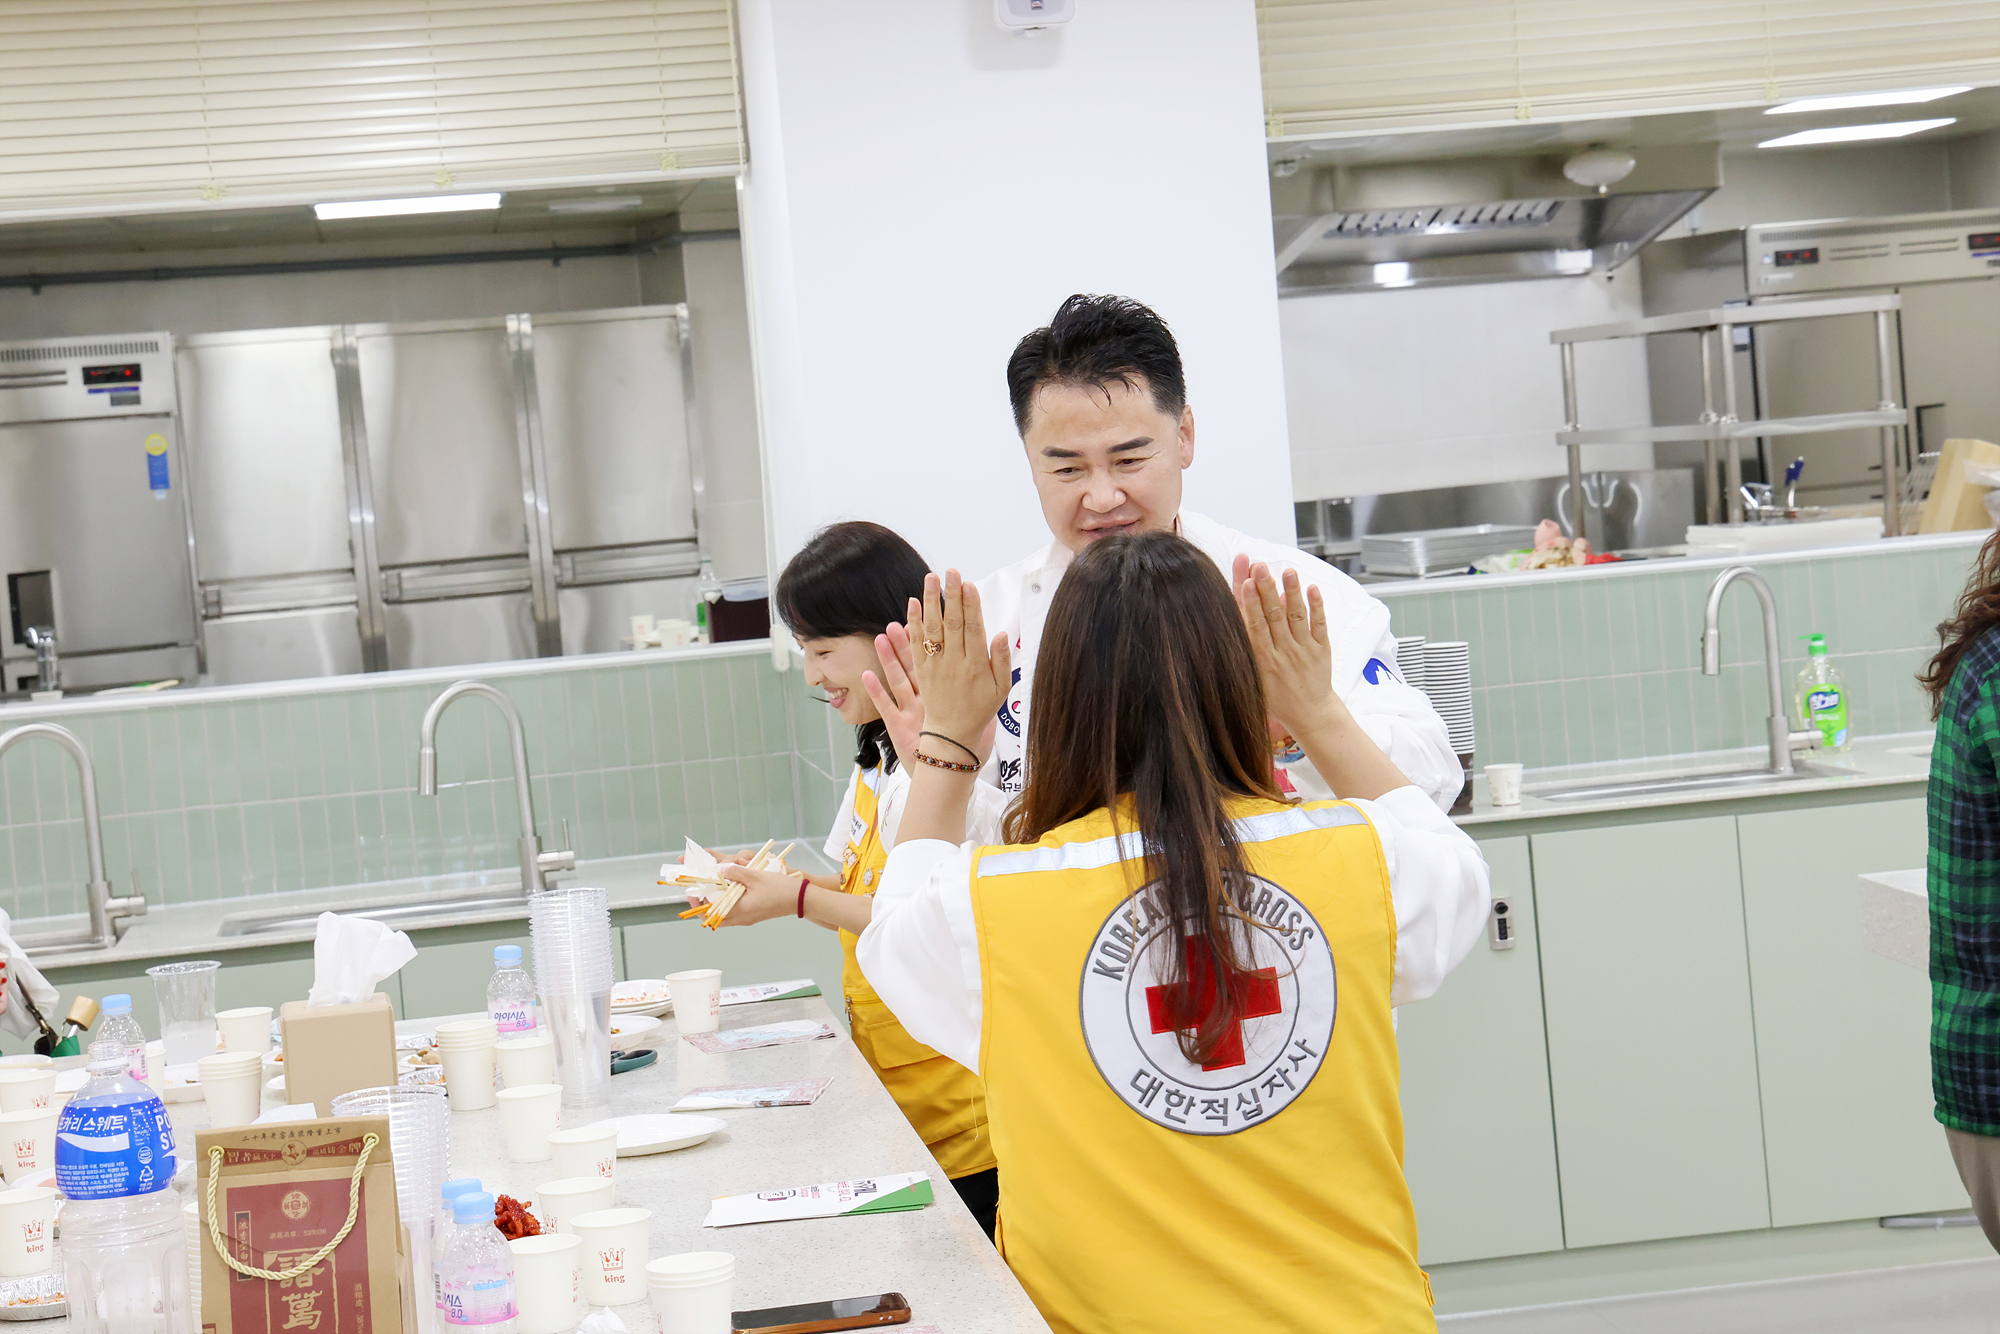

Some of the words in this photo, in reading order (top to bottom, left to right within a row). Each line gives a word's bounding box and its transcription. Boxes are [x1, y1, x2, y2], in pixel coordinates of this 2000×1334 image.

[1238, 881, 1314, 950] CROSS
[494, 1011, 526, 1021] 아이시스
[1129, 1038, 1319, 1126] 대한적십자사
[83, 1115, 124, 1131] 스웨트
[26, 1244, 45, 1254] king
[604, 1274, 626, 1283] king
[450, 1308, 463, 1319] 8.0
